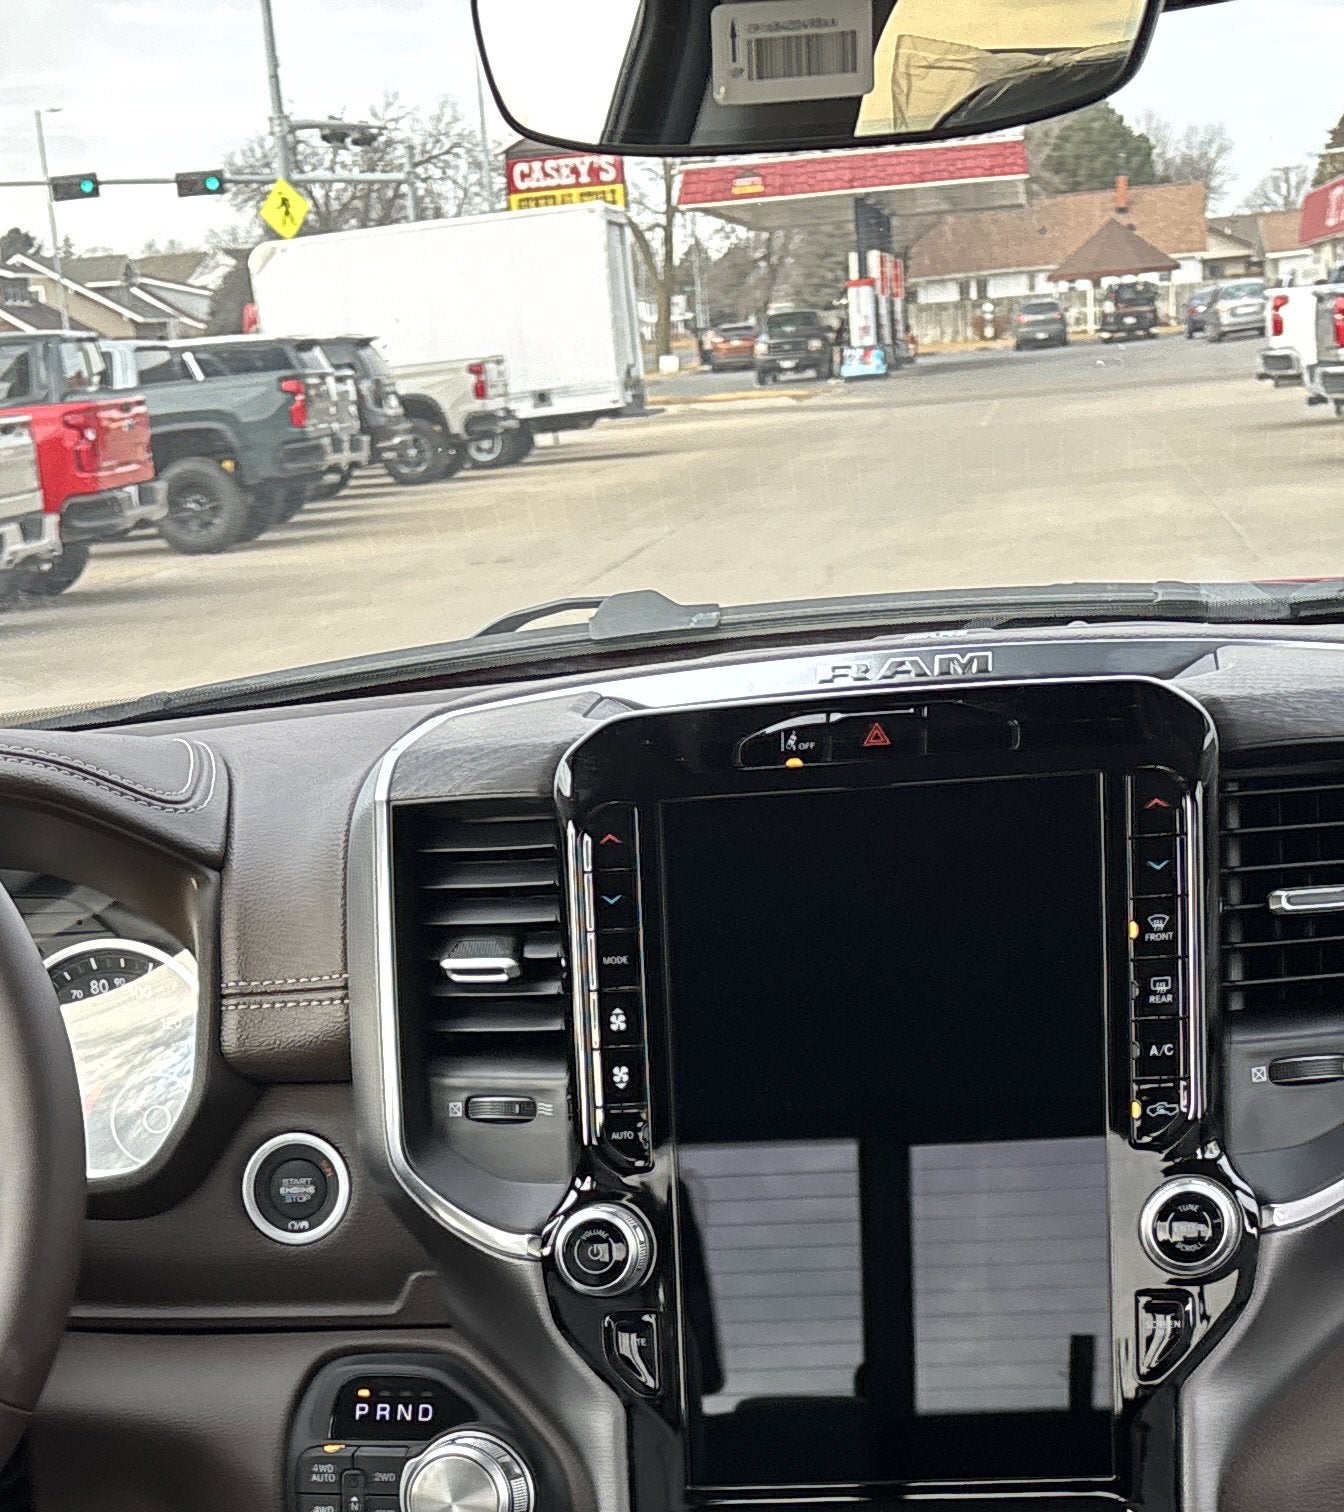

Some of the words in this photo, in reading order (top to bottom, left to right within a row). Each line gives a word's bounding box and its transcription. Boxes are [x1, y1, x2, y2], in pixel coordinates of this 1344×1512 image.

[513, 154, 617, 190] CASEY'S
[817, 650, 994, 684] RAM
[798, 740, 816, 750] OFF
[1144, 931, 1174, 942] FRONT
[602, 955, 629, 965] MODE
[89, 979, 109, 995] 80
[70, 989, 84, 1000] 70
[1148, 993, 1174, 1004] REAR
[1149, 1043, 1174, 1057] A/C
[610, 1129, 635, 1141] AUTO
[282, 1177, 312, 1186] START
[1177, 1203, 1200, 1213] TUNE
[579, 1228, 610, 1240] VOLUME
[311, 1463, 335, 1473] 4WD
[310, 1473, 336, 1483] AUTO
[373, 1472, 397, 1482] 2WD
